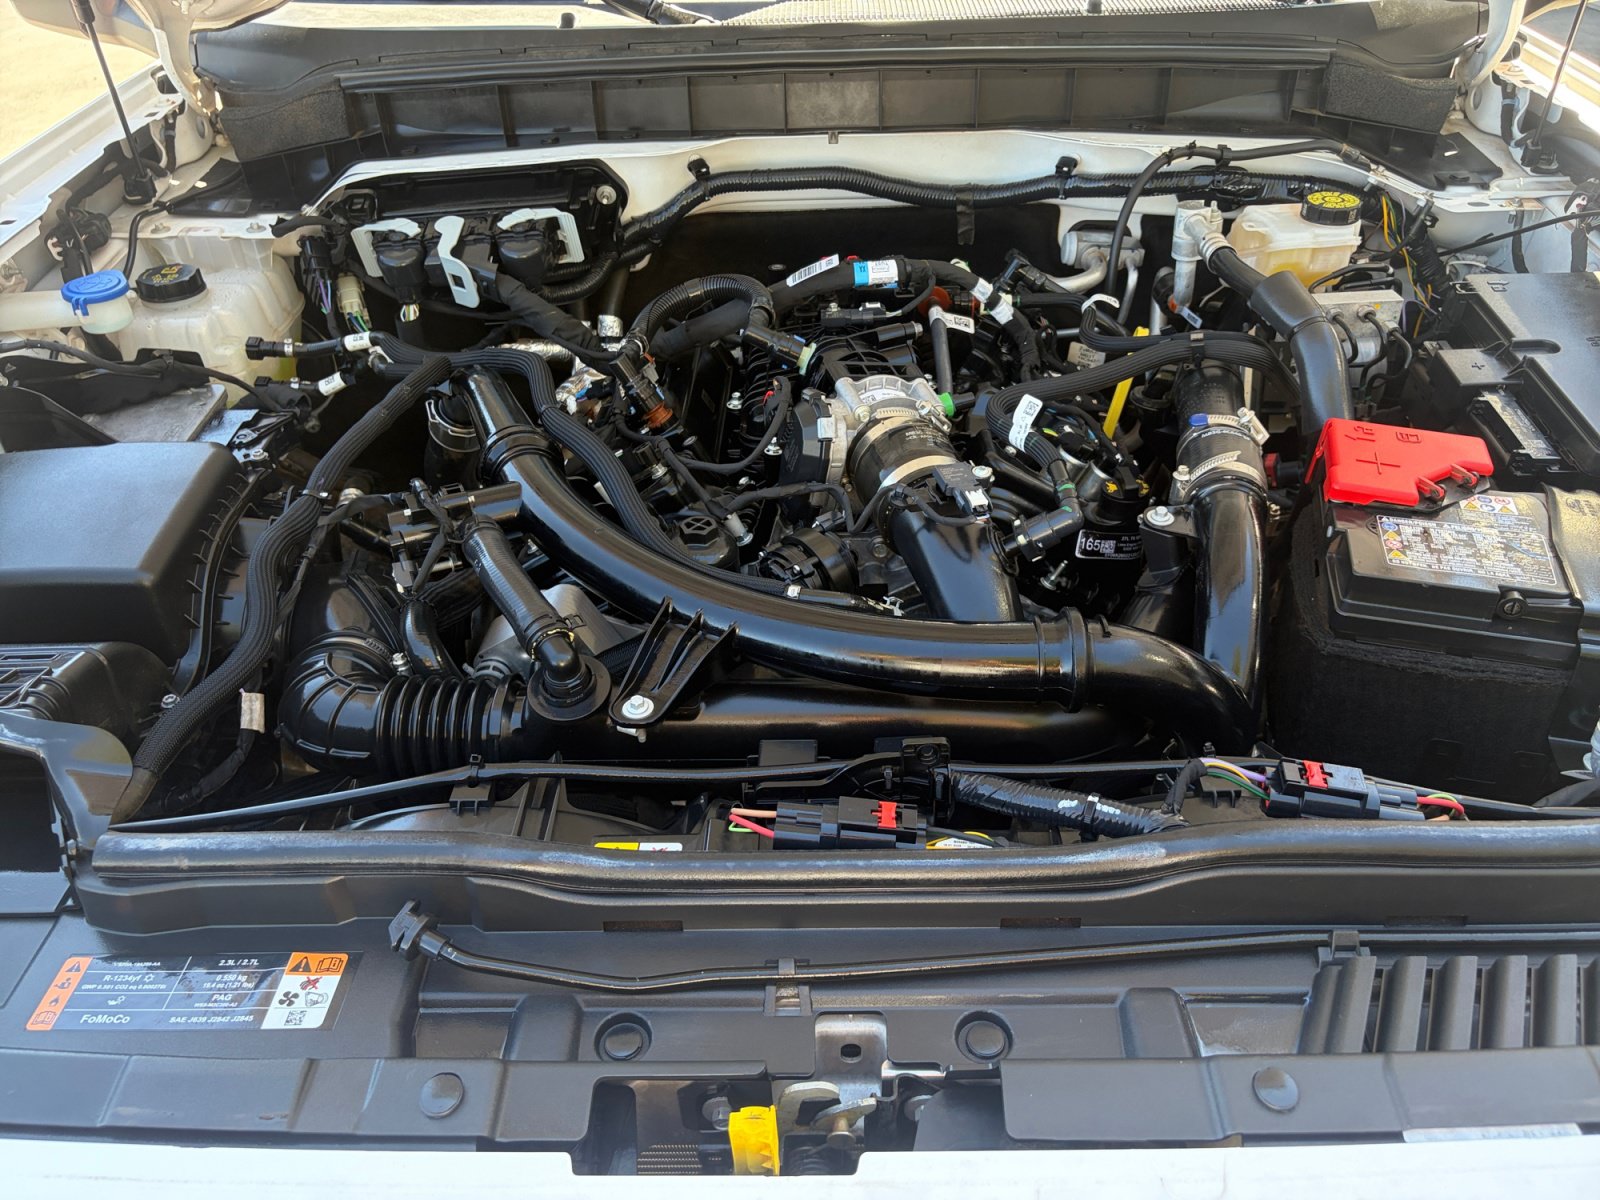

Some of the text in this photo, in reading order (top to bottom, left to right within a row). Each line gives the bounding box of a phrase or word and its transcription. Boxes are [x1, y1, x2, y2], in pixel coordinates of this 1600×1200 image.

[1080, 537, 1101, 551] 165
[241, 958, 260, 966] 2.7L
[102, 974, 142, 984] R-1234yf
[237, 974, 248, 983] kg
[211, 993, 233, 1001] PAG
[79, 1014, 131, 1024] FoMoCo
